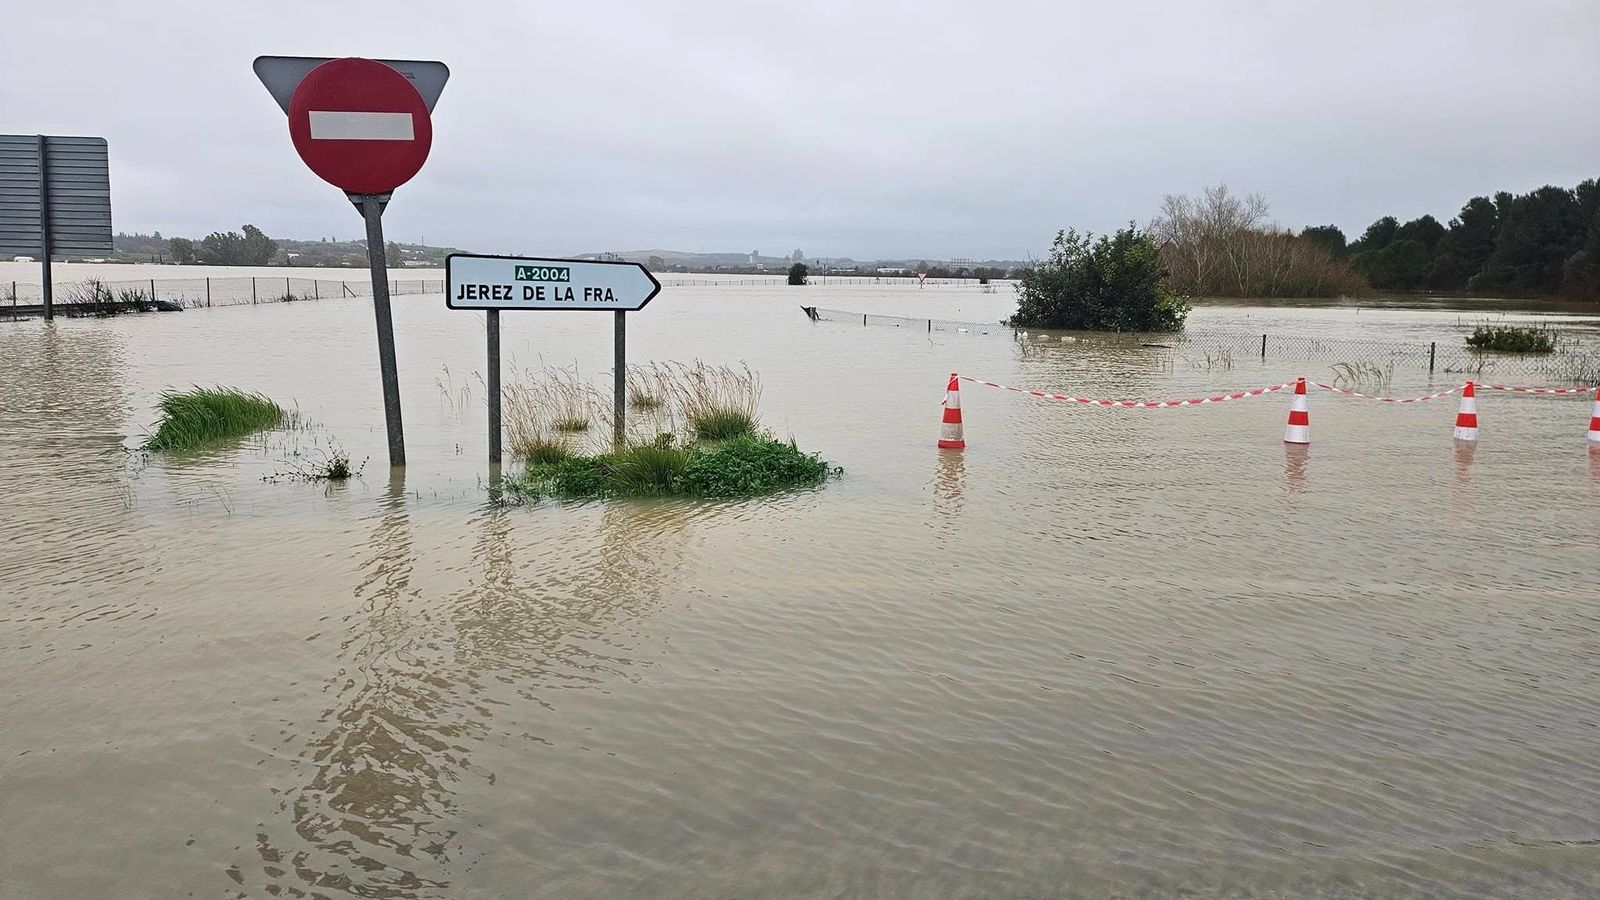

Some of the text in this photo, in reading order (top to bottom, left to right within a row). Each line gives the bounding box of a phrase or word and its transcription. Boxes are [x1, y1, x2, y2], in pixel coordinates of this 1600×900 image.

[517, 267, 568, 280] A-2004
[457, 284, 618, 302] JEREZ DE LA FRA.
